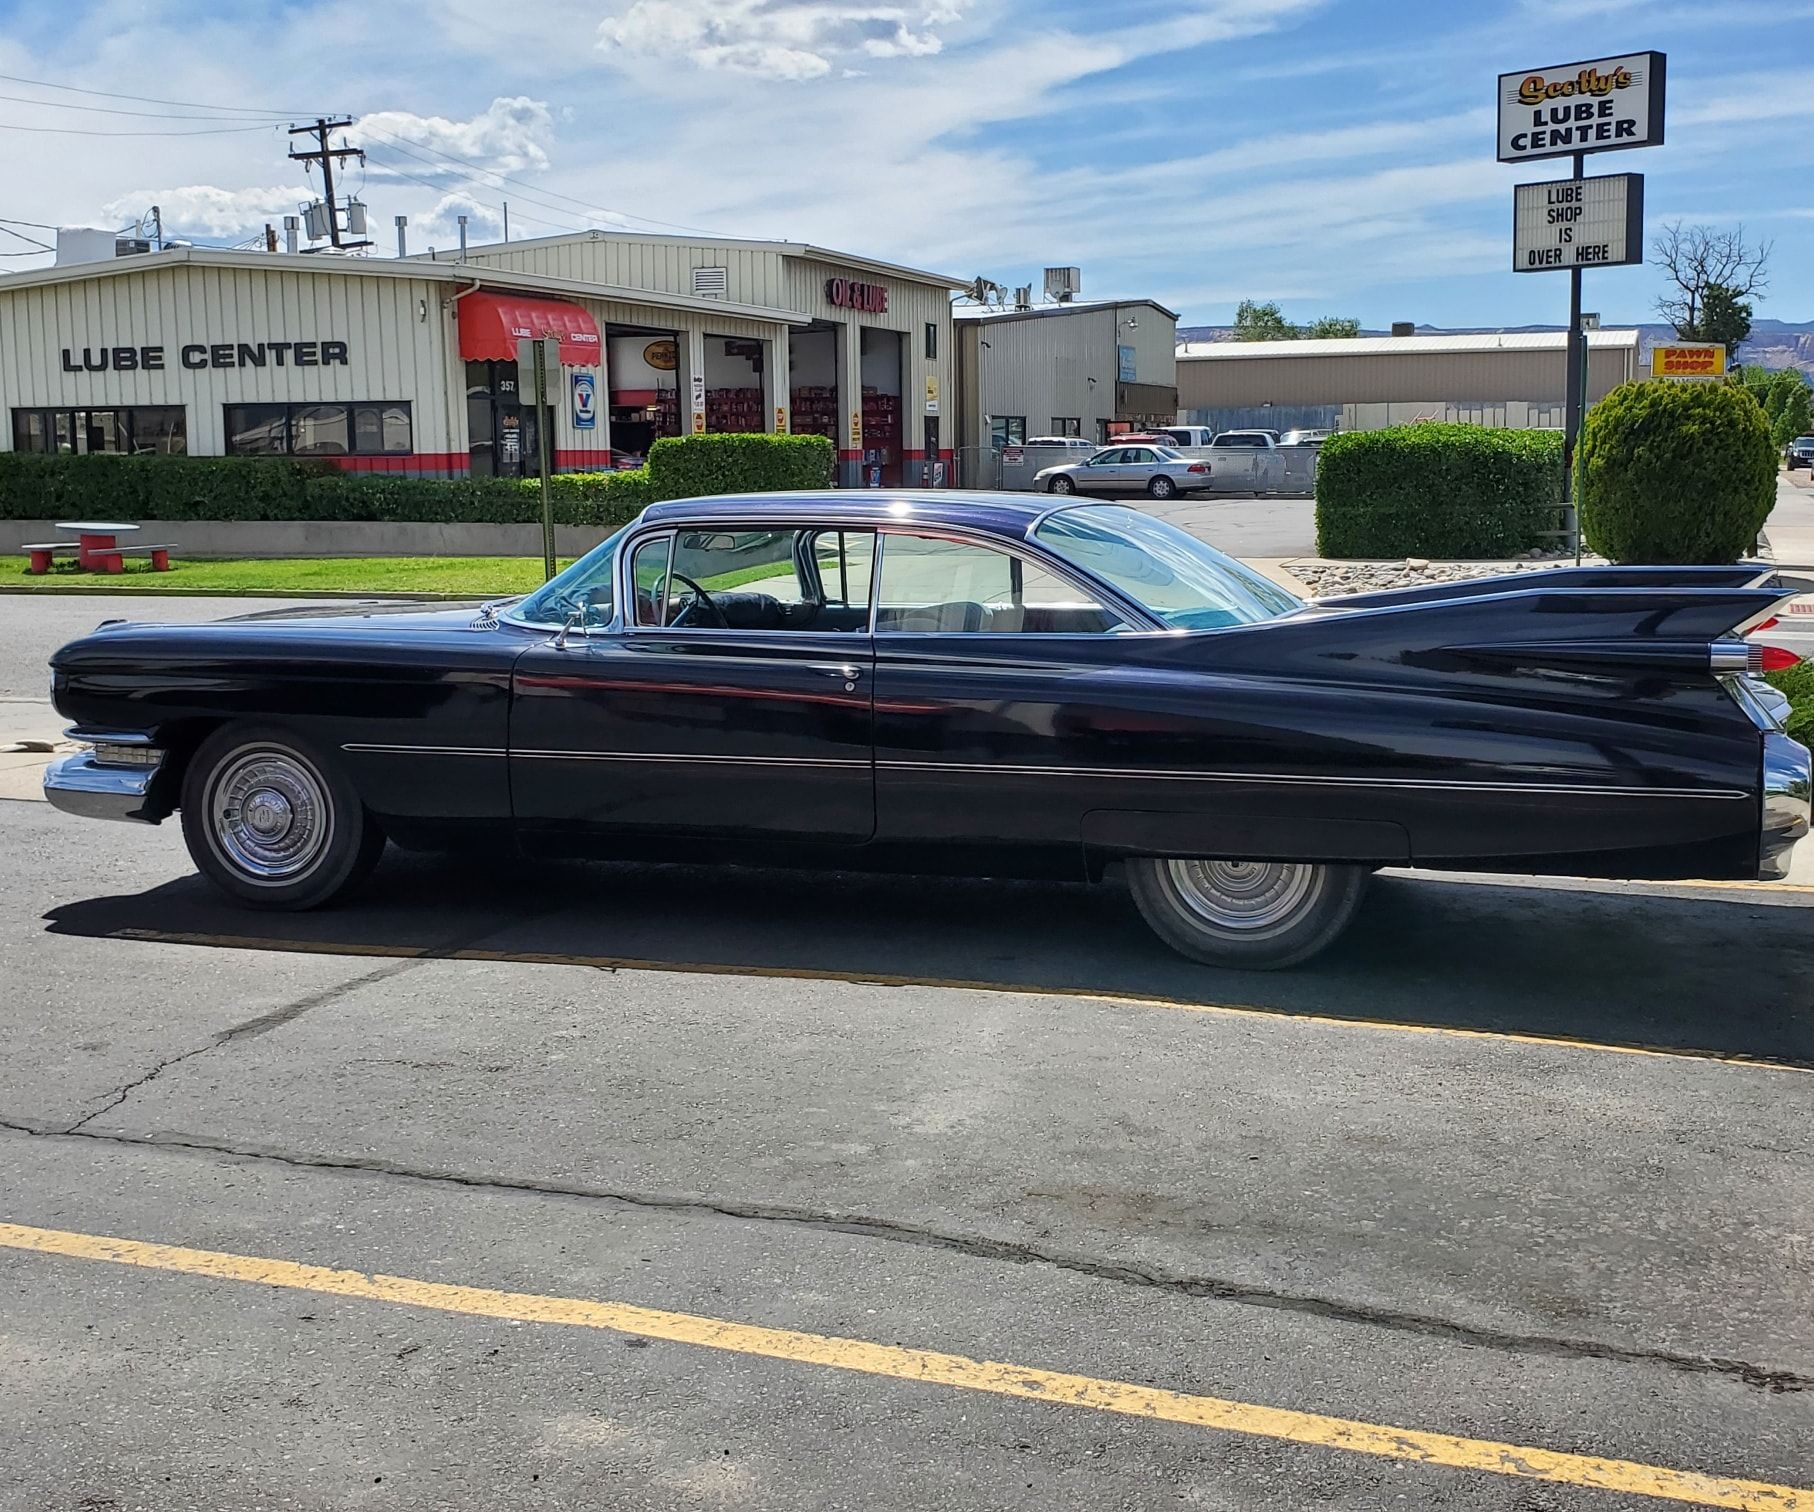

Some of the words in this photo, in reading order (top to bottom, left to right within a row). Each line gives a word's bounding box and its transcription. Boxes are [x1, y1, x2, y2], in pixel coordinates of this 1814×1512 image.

[1518, 66, 1632, 105] Scotty's
[1533, 99, 1614, 127] LUBE
[1511, 119, 1637, 151] CENTER
[1547, 186, 1583, 205] LUBE
[1547, 206, 1583, 224] SHOP
[1558, 227, 1573, 244] IS
[1528, 248, 1562, 266] OVER
[1575, 244, 1609, 262] HERE
[830, 278, 852, 307] OIL
[853, 282, 862, 310] &
[863, 285, 888, 314] LUBE
[511, 327, 532, 338] LUBE
[570, 333, 599, 344] CENTER
[61, 346, 165, 372] LUBE
[181, 341, 349, 370] CENTER
[1664, 349, 1715, 359] PAWN
[1664, 360, 1714, 370] SHOP
[500, 380, 514, 391] 357
